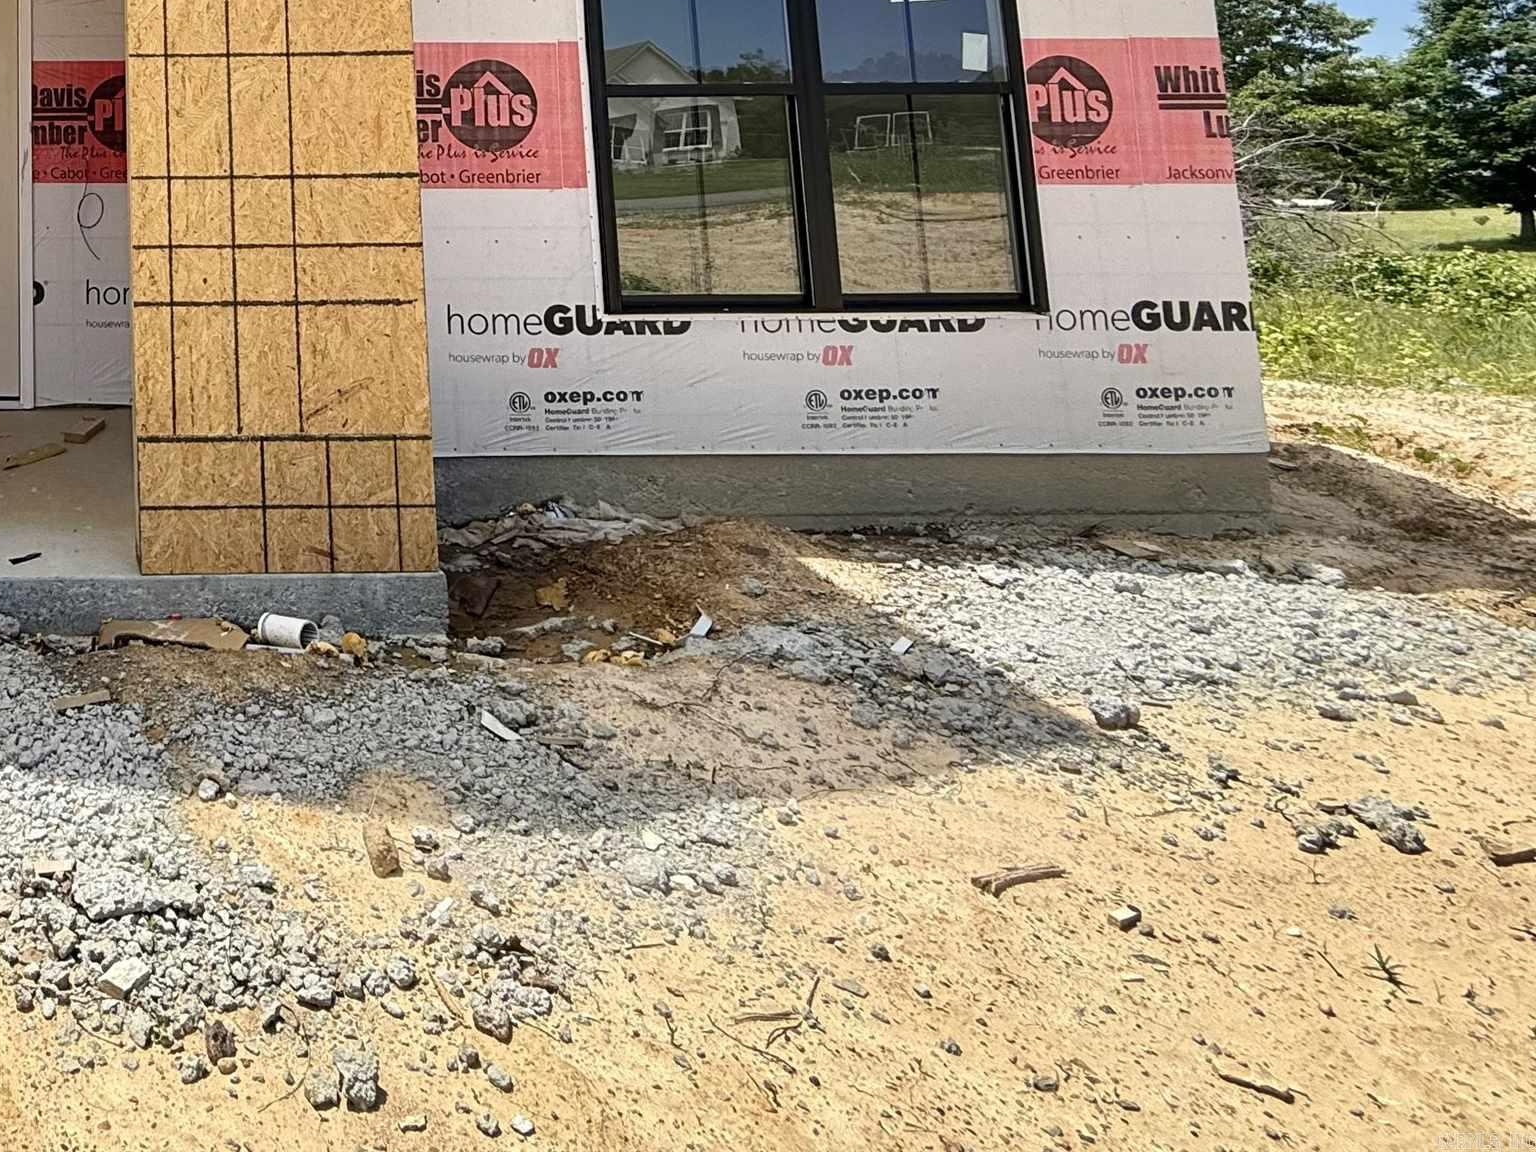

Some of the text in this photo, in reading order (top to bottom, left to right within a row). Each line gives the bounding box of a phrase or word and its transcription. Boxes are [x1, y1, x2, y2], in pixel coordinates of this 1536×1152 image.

[1154, 65, 1222, 94] Whit
[449, 86, 535, 128] Plus
[1027, 83, 1111, 125] Plus
[435, 142, 467, 161] Plus
[490, 144, 540, 163] Service
[1069, 139, 1117, 159] Service
[50, 166, 90, 180] Cabot
[458, 168, 542, 184] Greenbrier
[1038, 165, 1120, 181] Greenbrier
[447, 347, 561, 369] housewrap by OX
[742, 344, 855, 367] housewrap by OX
[1037, 343, 1150, 365] housewrap by OX
